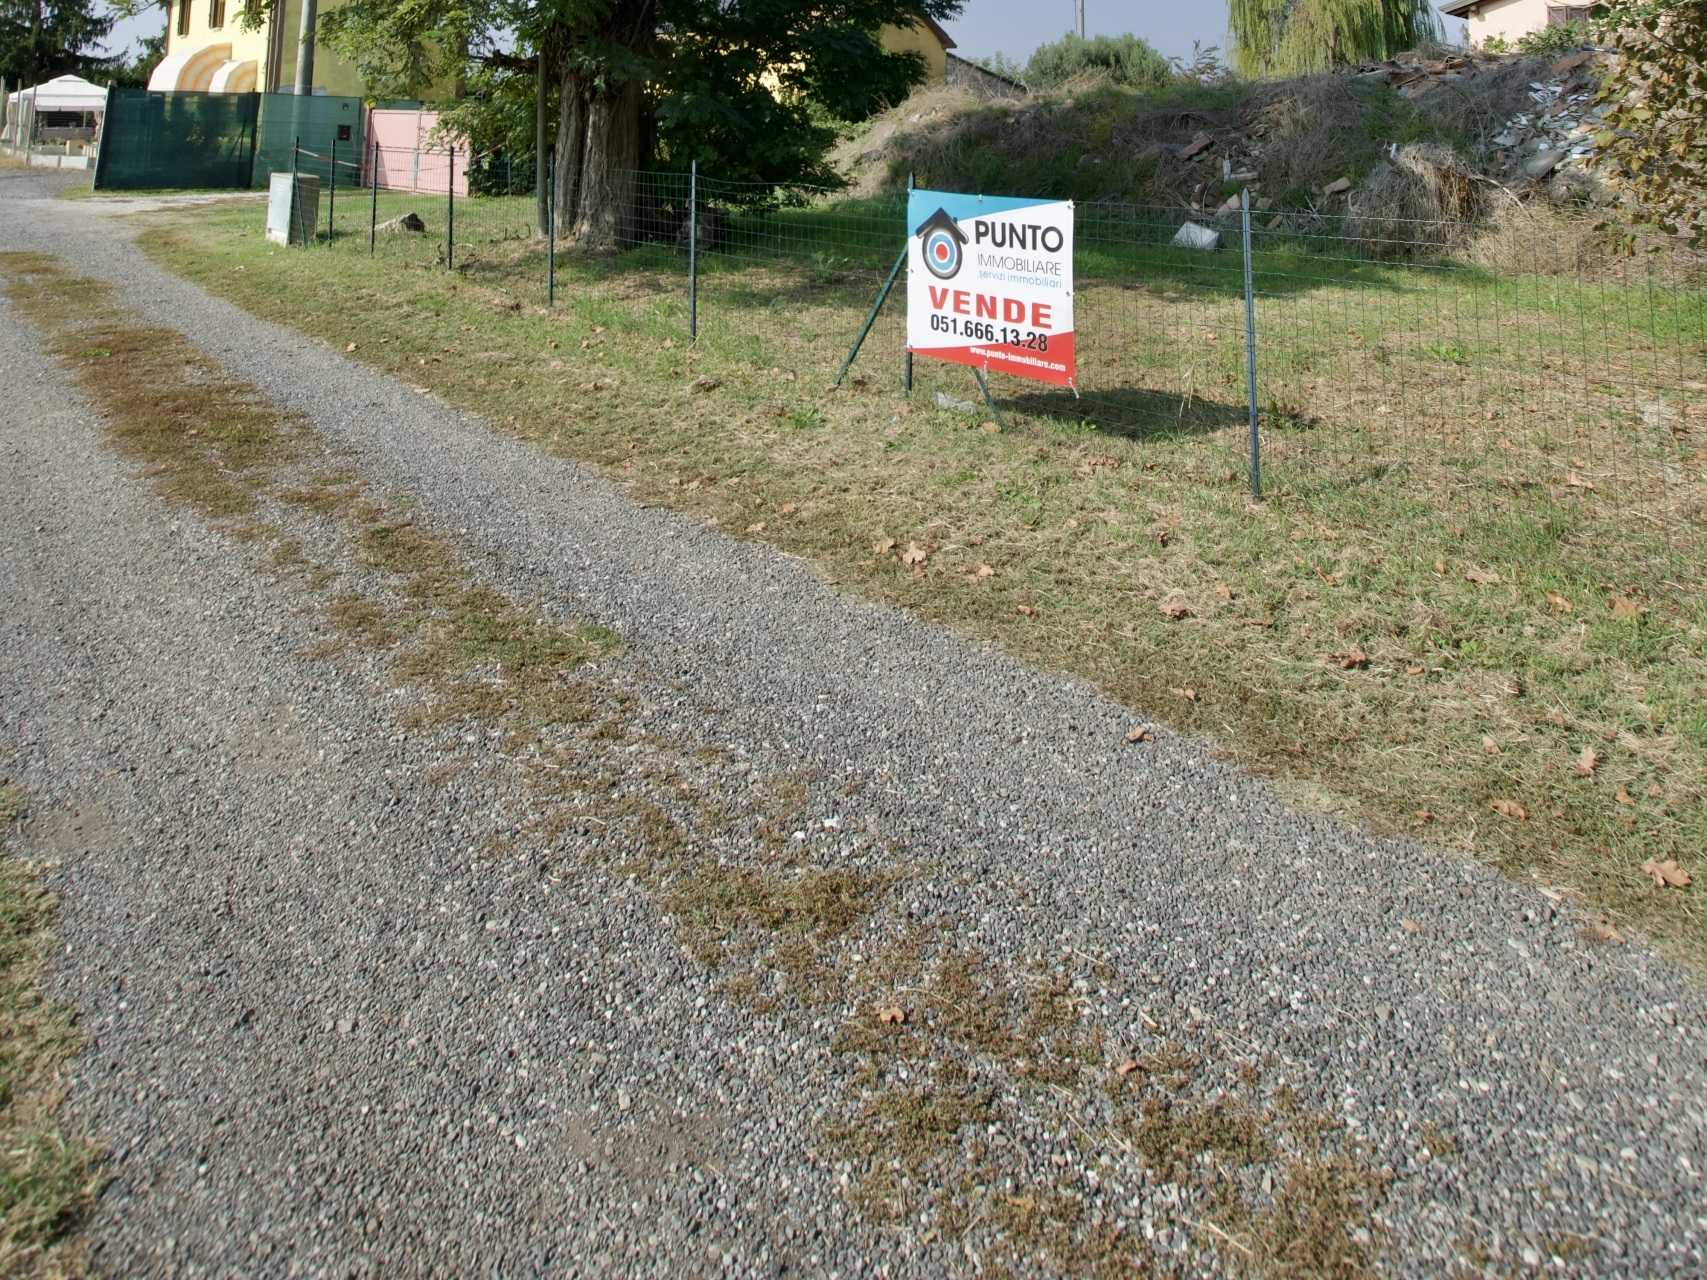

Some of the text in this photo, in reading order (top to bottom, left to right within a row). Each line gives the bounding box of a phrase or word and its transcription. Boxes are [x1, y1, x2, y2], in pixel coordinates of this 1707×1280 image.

[975, 220, 1064, 253] PUNTO
[977, 253, 1062, 276] IMMOBILIARE
[977, 270, 1062, 288] servizi immobiliari
[928, 285, 1052, 329] VENDE
[930, 314, 1048, 352] 051.666.13.28
[970, 346, 1066, 372] www.punto-immobiliare.com
